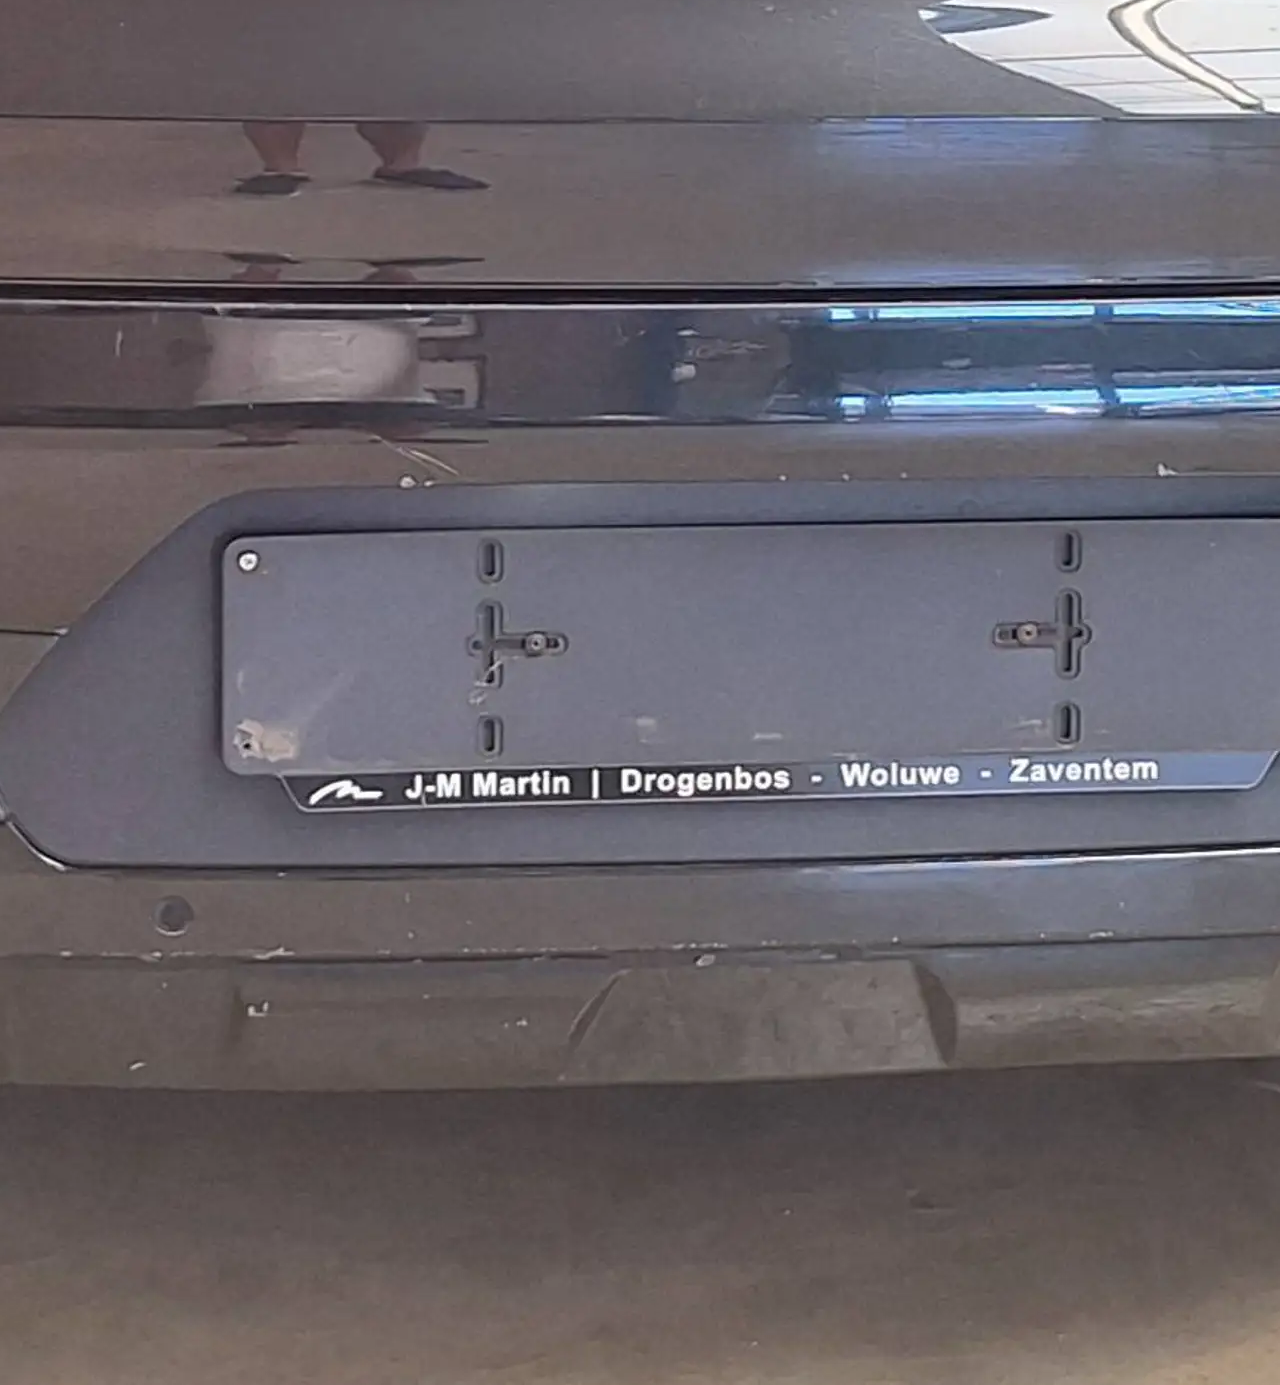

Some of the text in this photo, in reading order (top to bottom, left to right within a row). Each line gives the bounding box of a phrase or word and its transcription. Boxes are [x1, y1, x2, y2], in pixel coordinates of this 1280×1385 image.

[405, 772, 461, 799] J-M
[474, 770, 570, 797] Martin
[622, 767, 790, 796] Drogenbos
[841, 762, 960, 788] Woluwe
[1009, 759, 1158, 783] Zaventem
